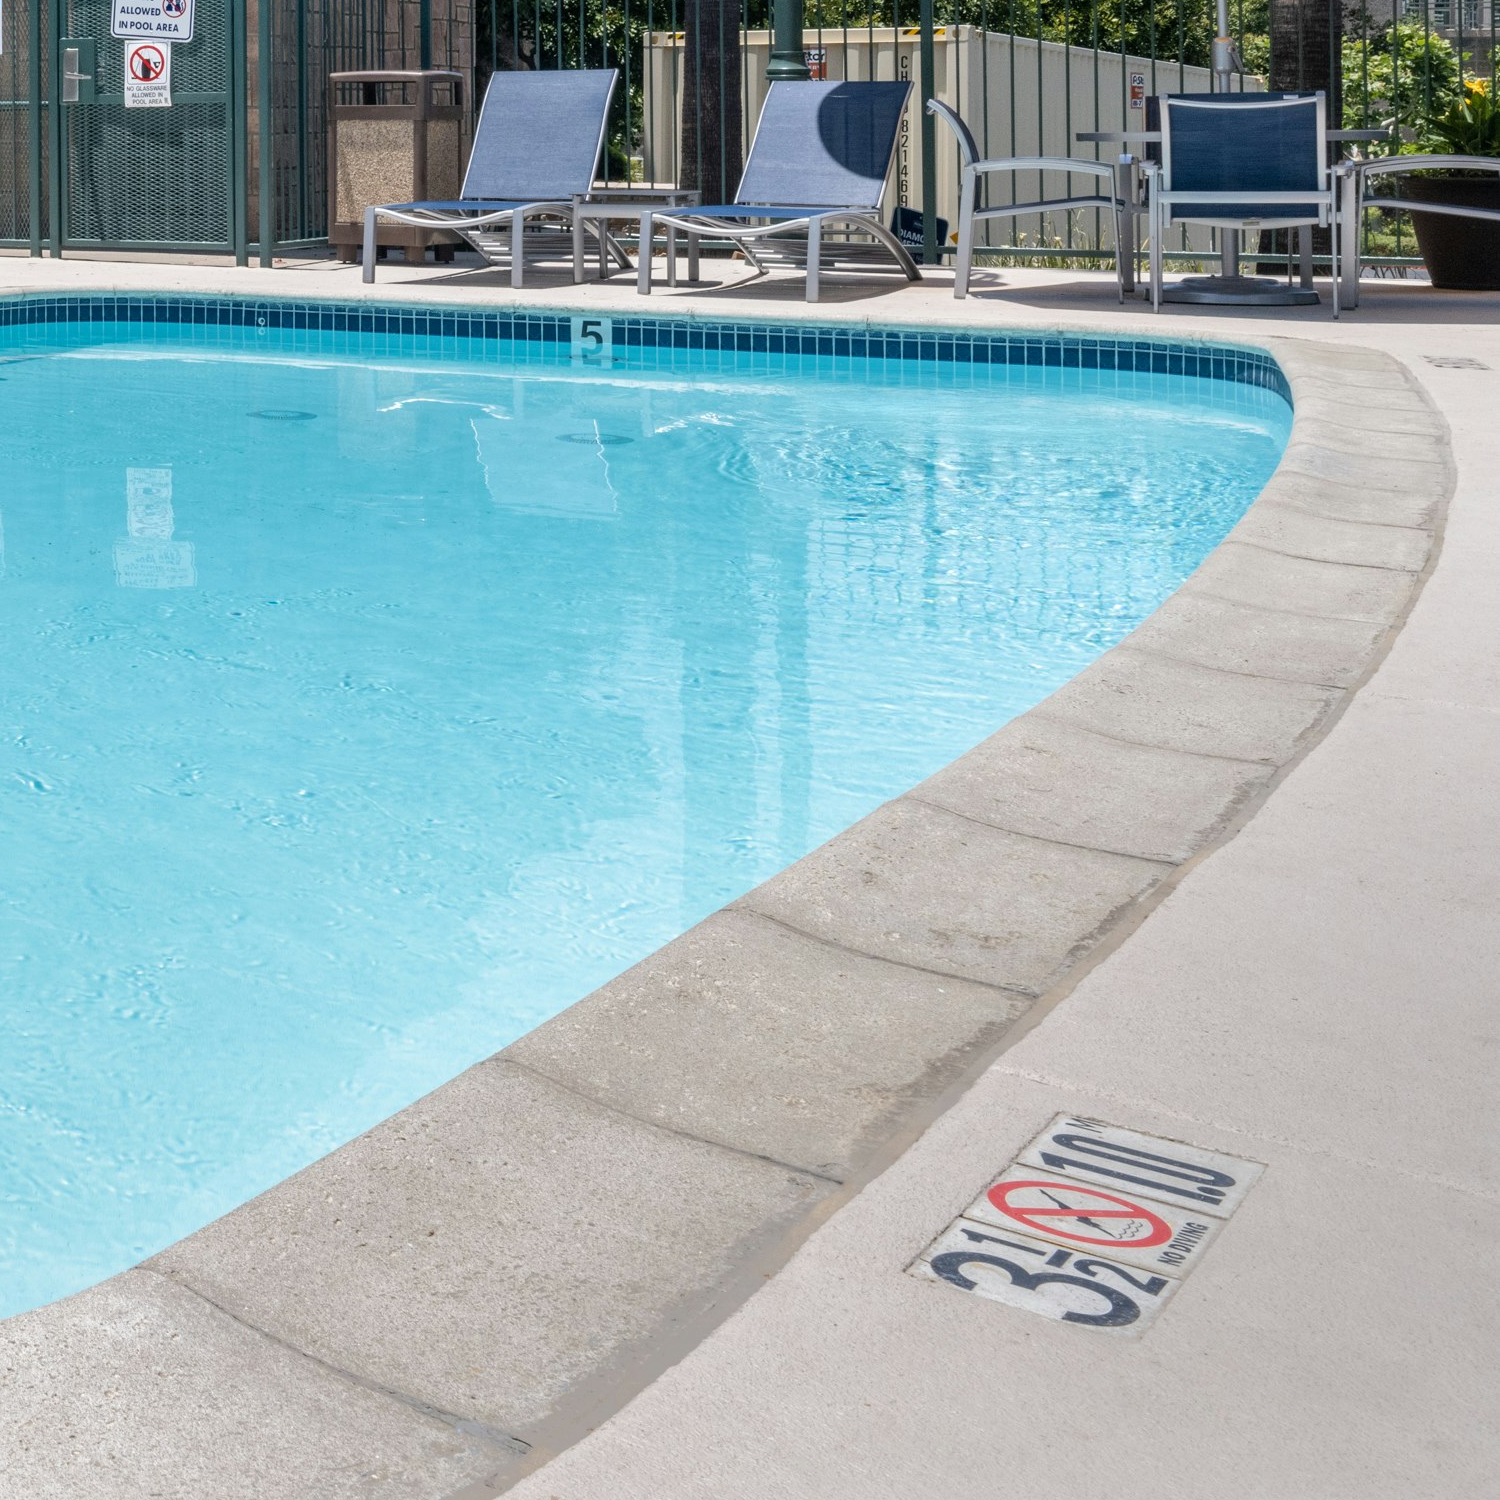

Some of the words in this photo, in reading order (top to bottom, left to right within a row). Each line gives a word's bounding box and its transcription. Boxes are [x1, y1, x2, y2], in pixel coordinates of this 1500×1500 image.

[120, 6, 161, 16] ALLOWED
[119, 20, 128, 29] IN
[130, 22, 153, 30] POOL
[156, 23, 178, 32] AREA
[581, 320, 604, 344] 5
[1156, 1250, 1186, 1268] NO
[1177, 1221, 1210, 1253] DIVING
